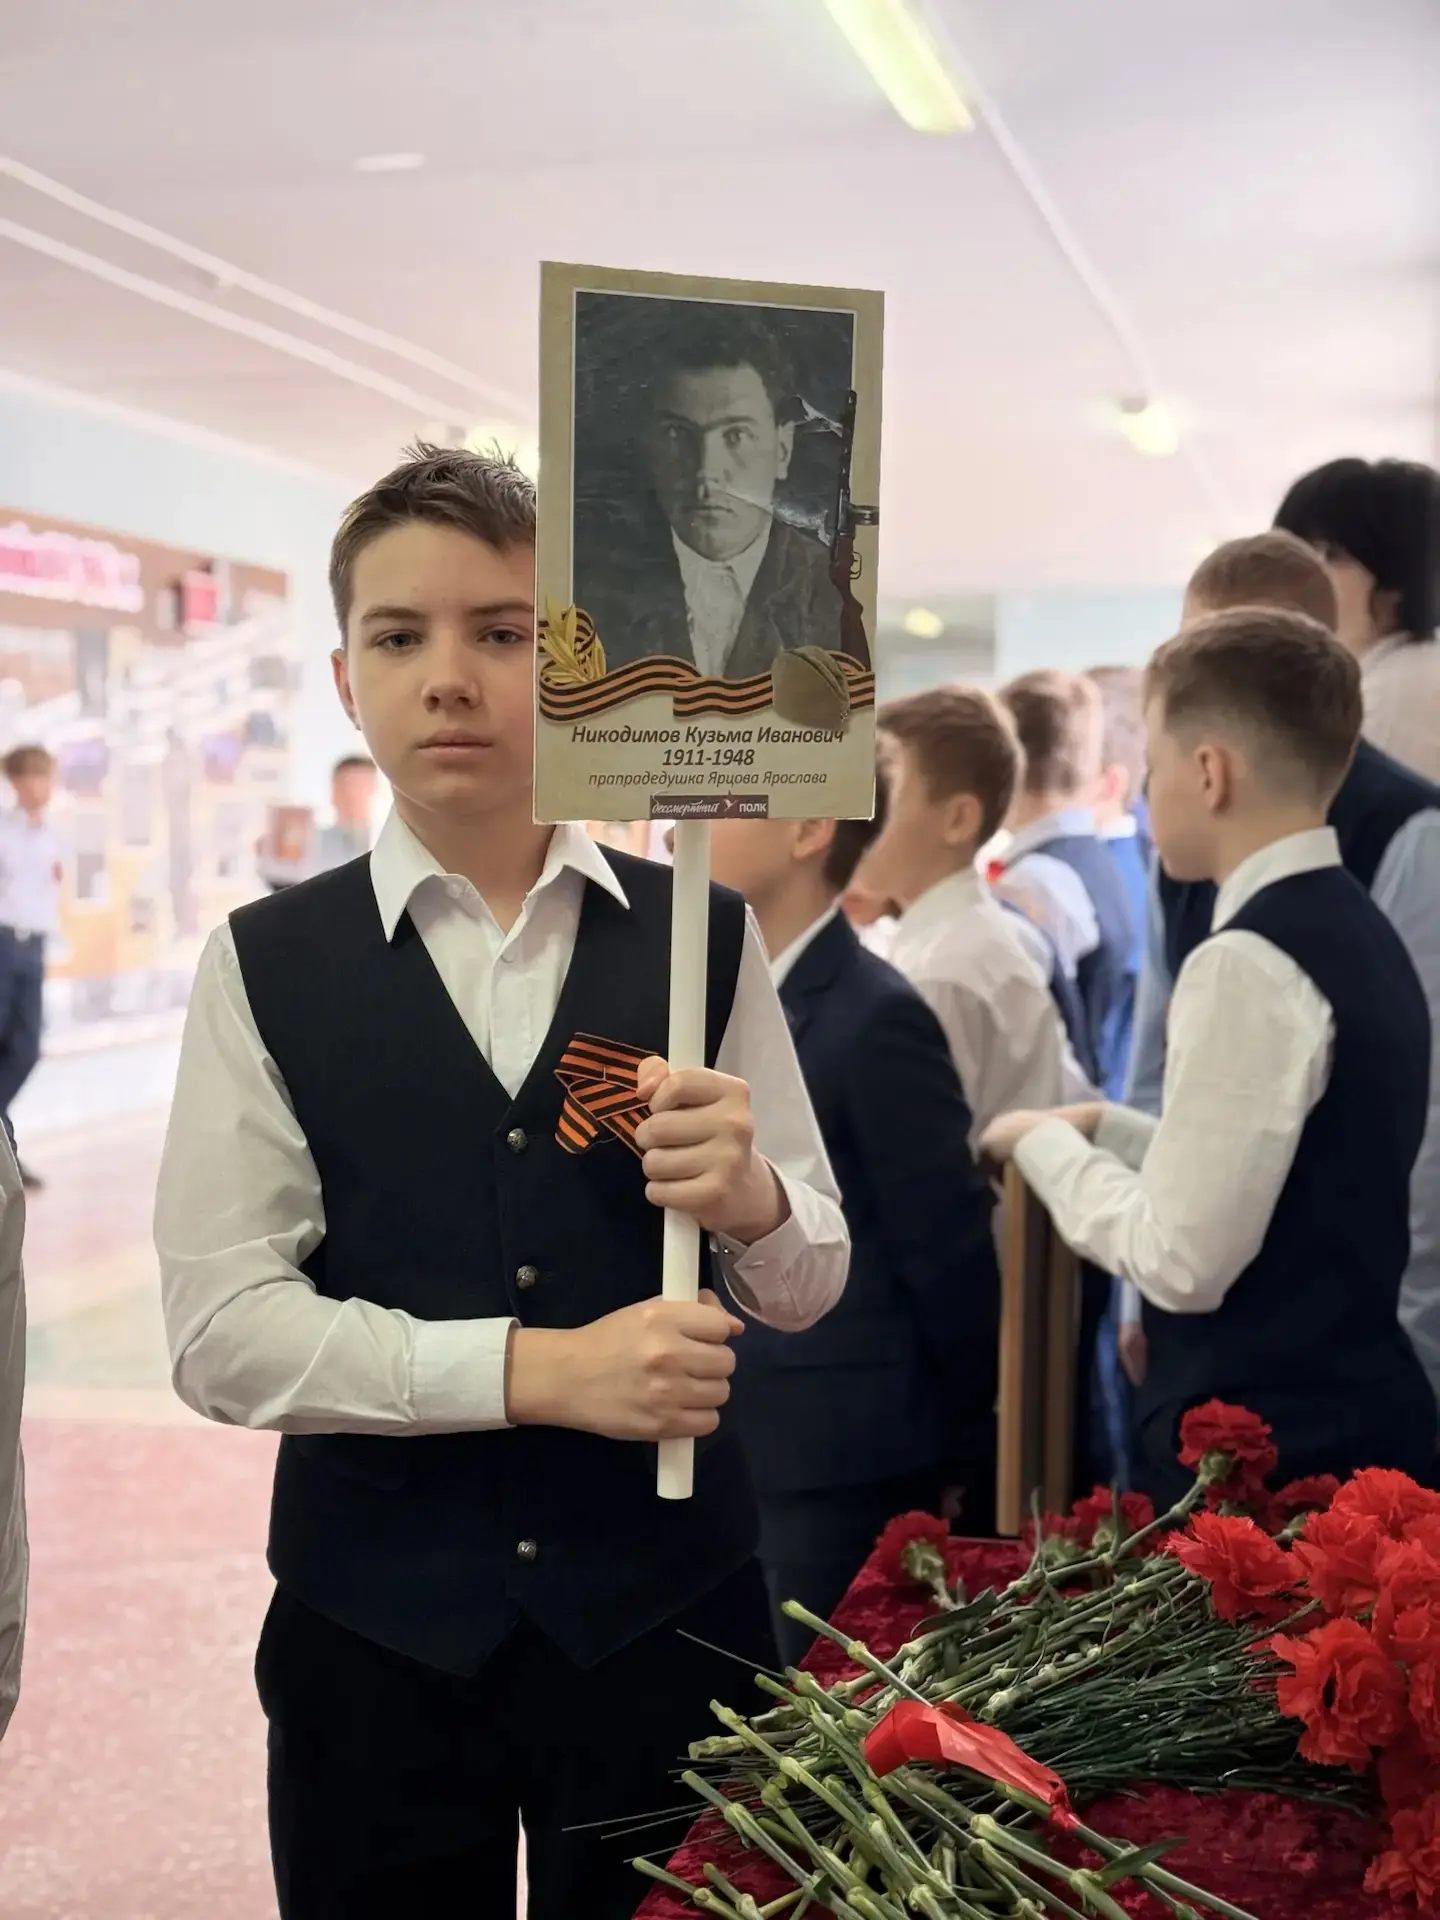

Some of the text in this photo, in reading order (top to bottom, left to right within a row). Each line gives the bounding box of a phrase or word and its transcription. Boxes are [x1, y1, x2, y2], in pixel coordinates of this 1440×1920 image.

[571, 725, 844, 747] Никодимов Кузьма Иванович
[661, 748, 756, 766] 1911-1948
[588, 770, 828, 788] прапрадедушка Ярцова Ярослава
